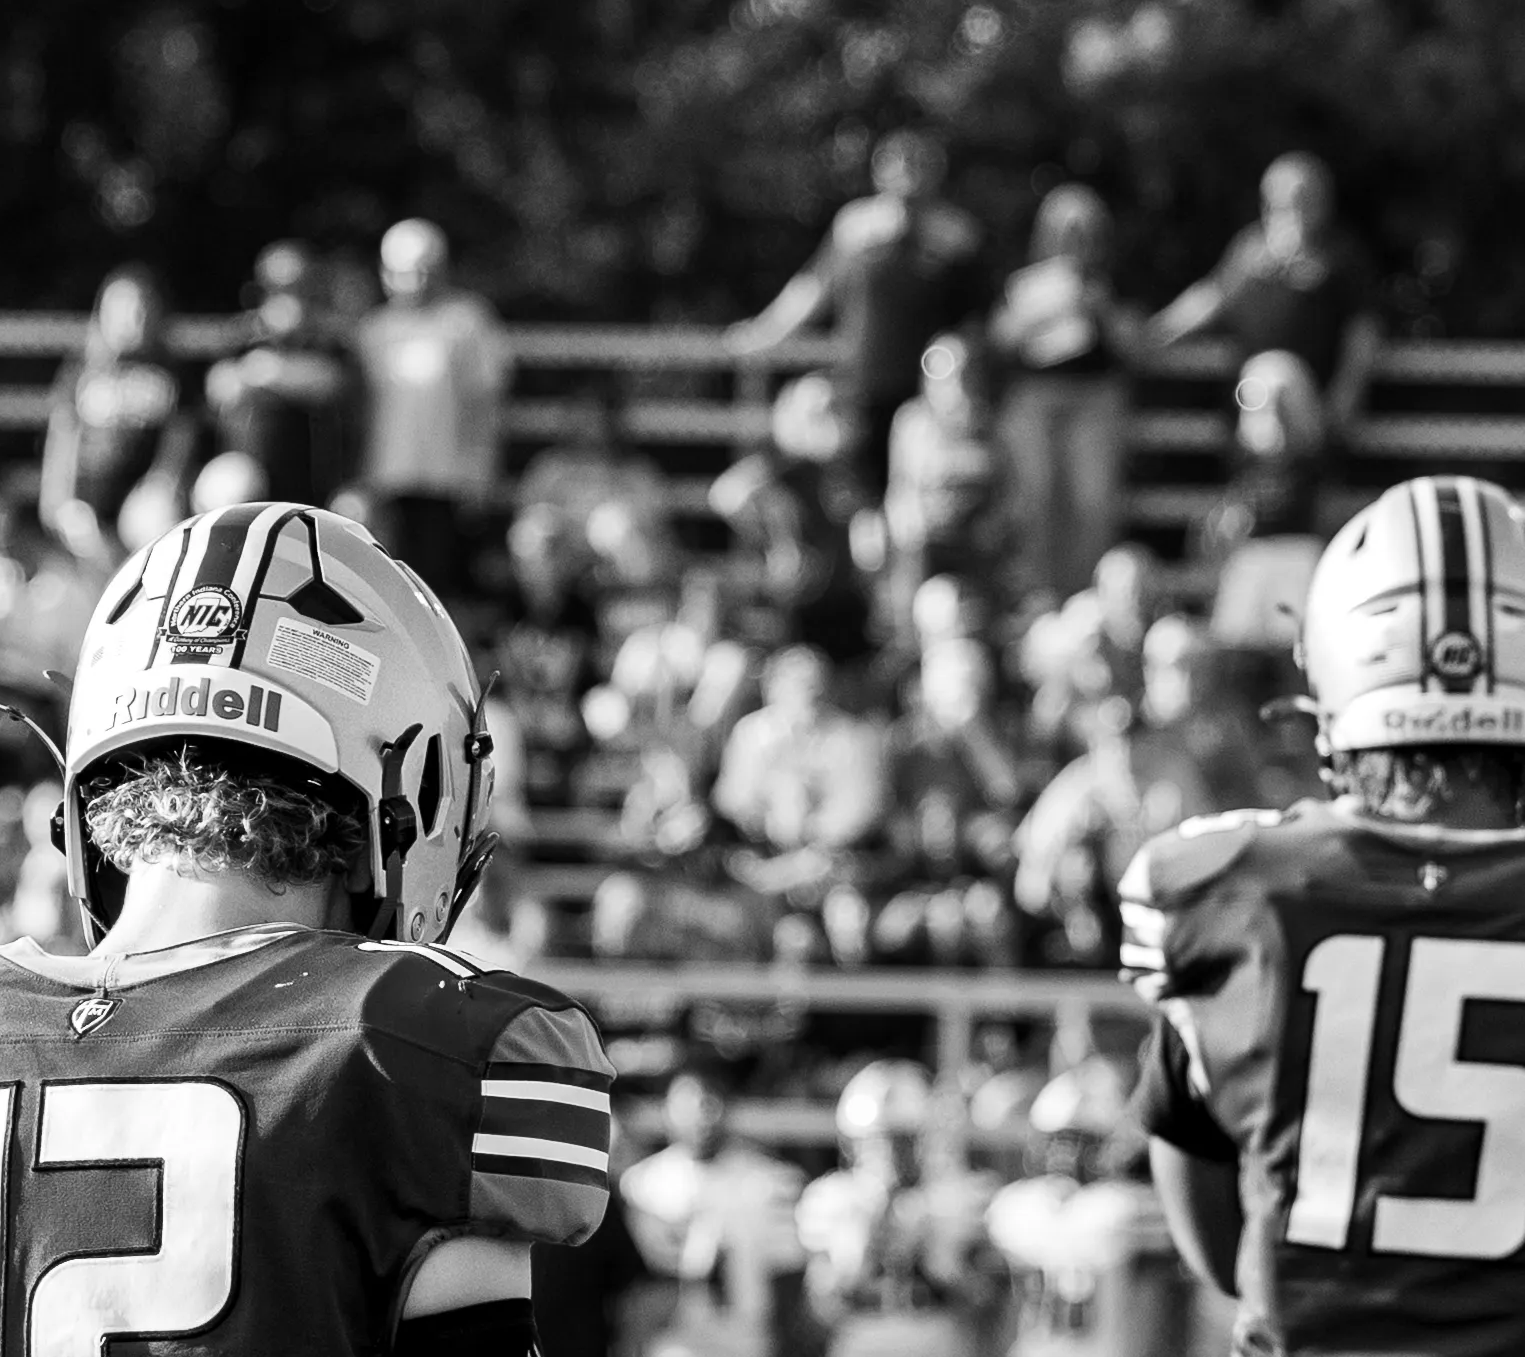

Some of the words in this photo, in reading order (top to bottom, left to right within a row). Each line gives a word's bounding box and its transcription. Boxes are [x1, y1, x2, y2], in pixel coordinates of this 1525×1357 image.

[179, 605, 231, 627] NIC
[192, 586, 223, 595] Indiana
[223, 589, 240, 629] Conference
[190, 645, 222, 654] YEARS
[312, 629, 350, 650] WARNING
[105, 676, 282, 733] Riddell
